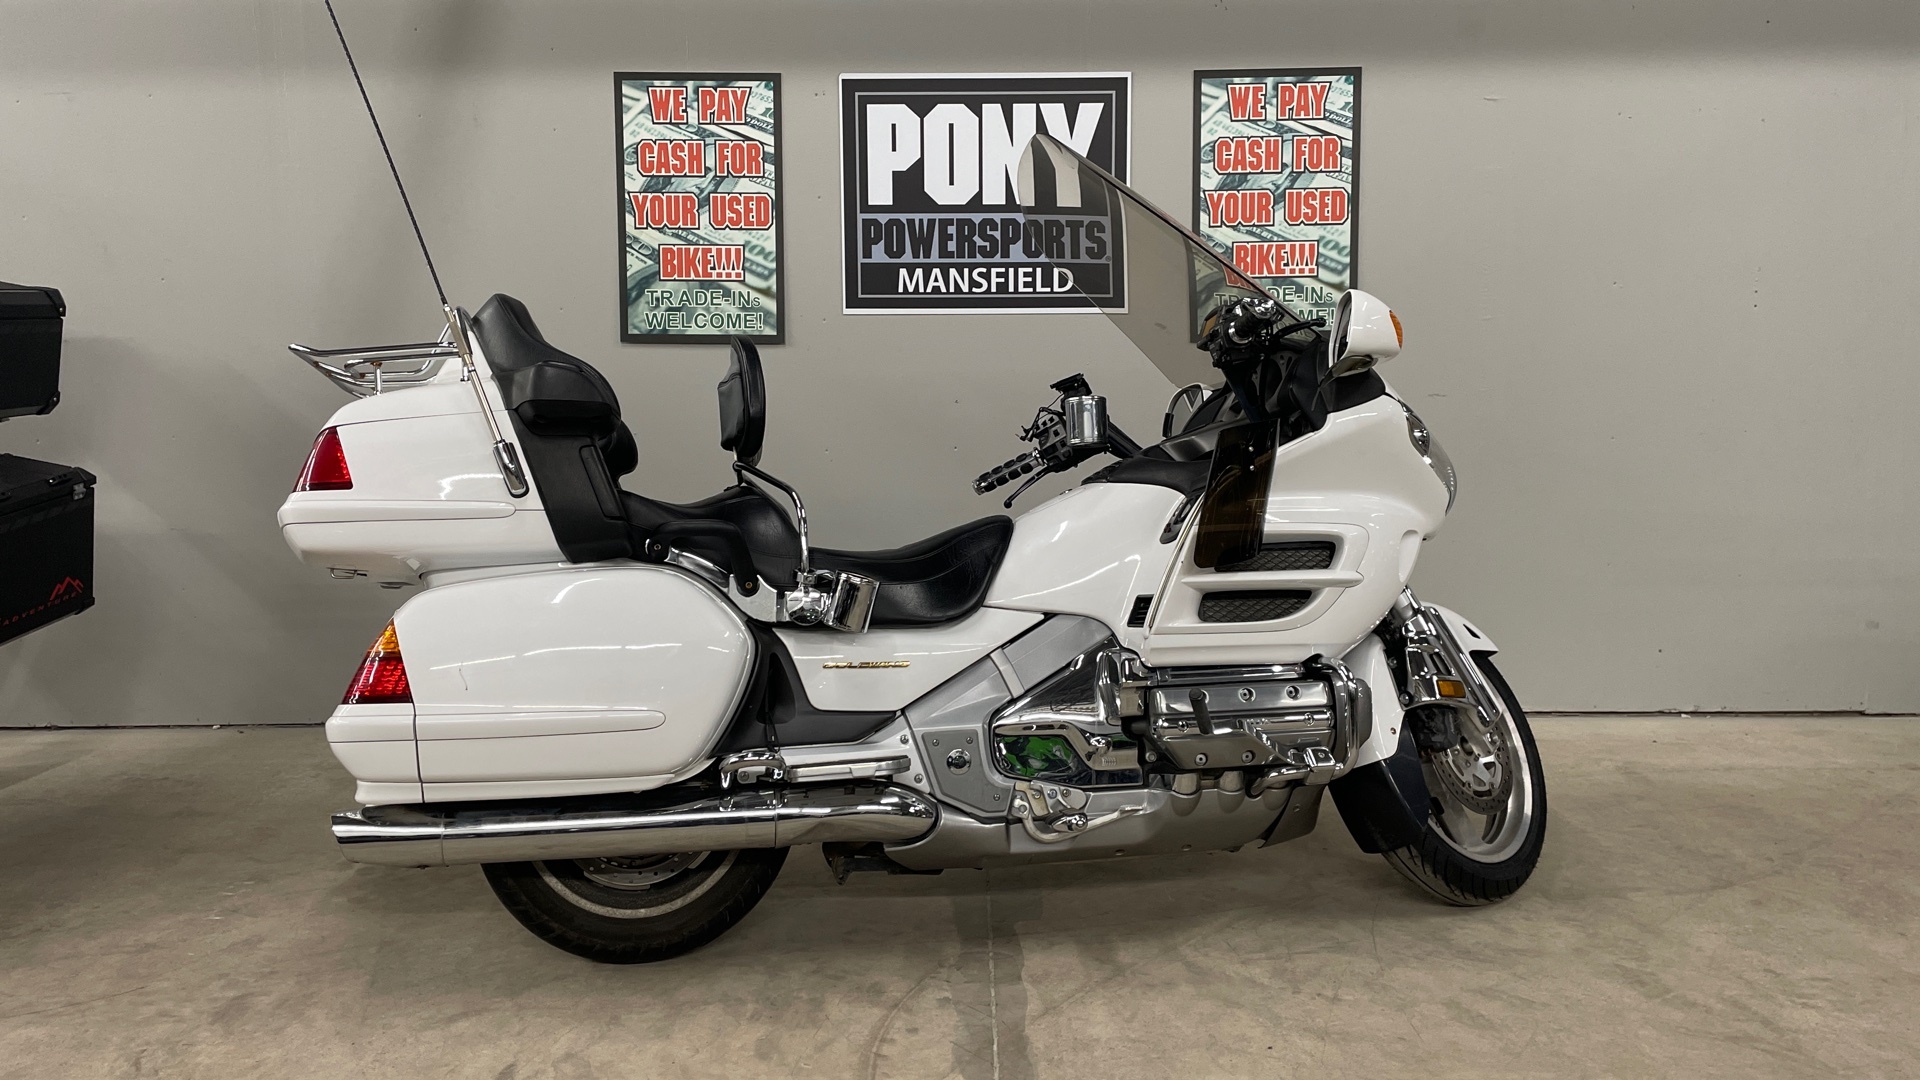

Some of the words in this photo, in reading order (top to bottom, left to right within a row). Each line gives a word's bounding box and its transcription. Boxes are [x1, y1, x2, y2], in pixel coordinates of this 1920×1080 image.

[648, 86, 688, 124] WE
[698, 86, 751, 124] PAY
[1226, 83, 1267, 121] WE
[1277, 82, 1331, 120] PAY
[637, 139, 706, 177] CASH
[715, 139, 764, 177] FOR
[866, 102, 1105, 208] PONY
[1213, 136, 1283, 173] CASH
[1291, 135, 1342, 173] FOR
[629, 192, 700, 230] YOUR
[708, 192, 774, 230] USED
[1204, 189, 1275, 227] YOUR
[1283, 188, 1349, 225] USED
[861, 218, 1108, 260] POWERSPORTS
[658, 244, 745, 281] BIKE!!!
[1232, 240, 1319, 278] BIKE!!!
[898, 267, 1075, 293] MANSFIELD
[645, 312, 764, 331] WELCOME!
